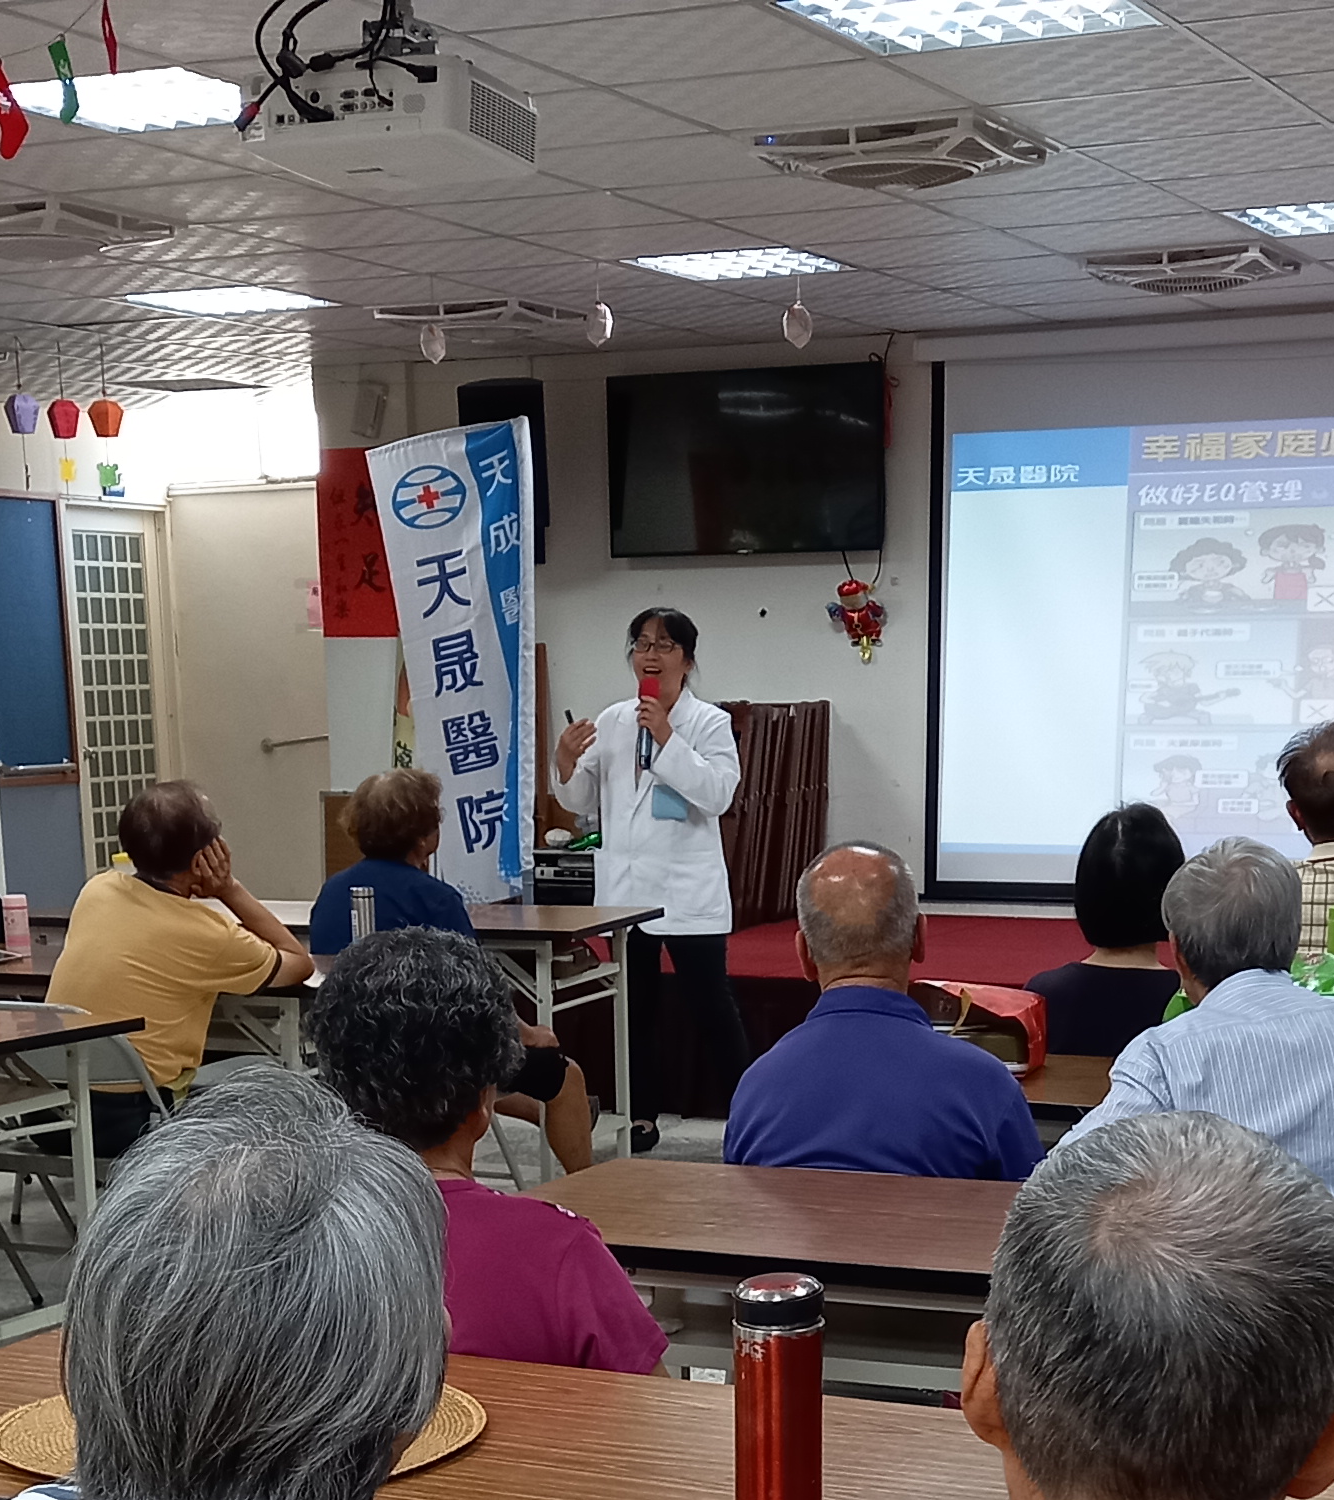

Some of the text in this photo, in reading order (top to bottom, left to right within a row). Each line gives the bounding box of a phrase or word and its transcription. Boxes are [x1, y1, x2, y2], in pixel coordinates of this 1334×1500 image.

[957, 463, 1080, 487] 天晟醫院
[1138, 480, 1303, 508] 做好EQ管理
[415, 548, 510, 854] 天晟醫院
